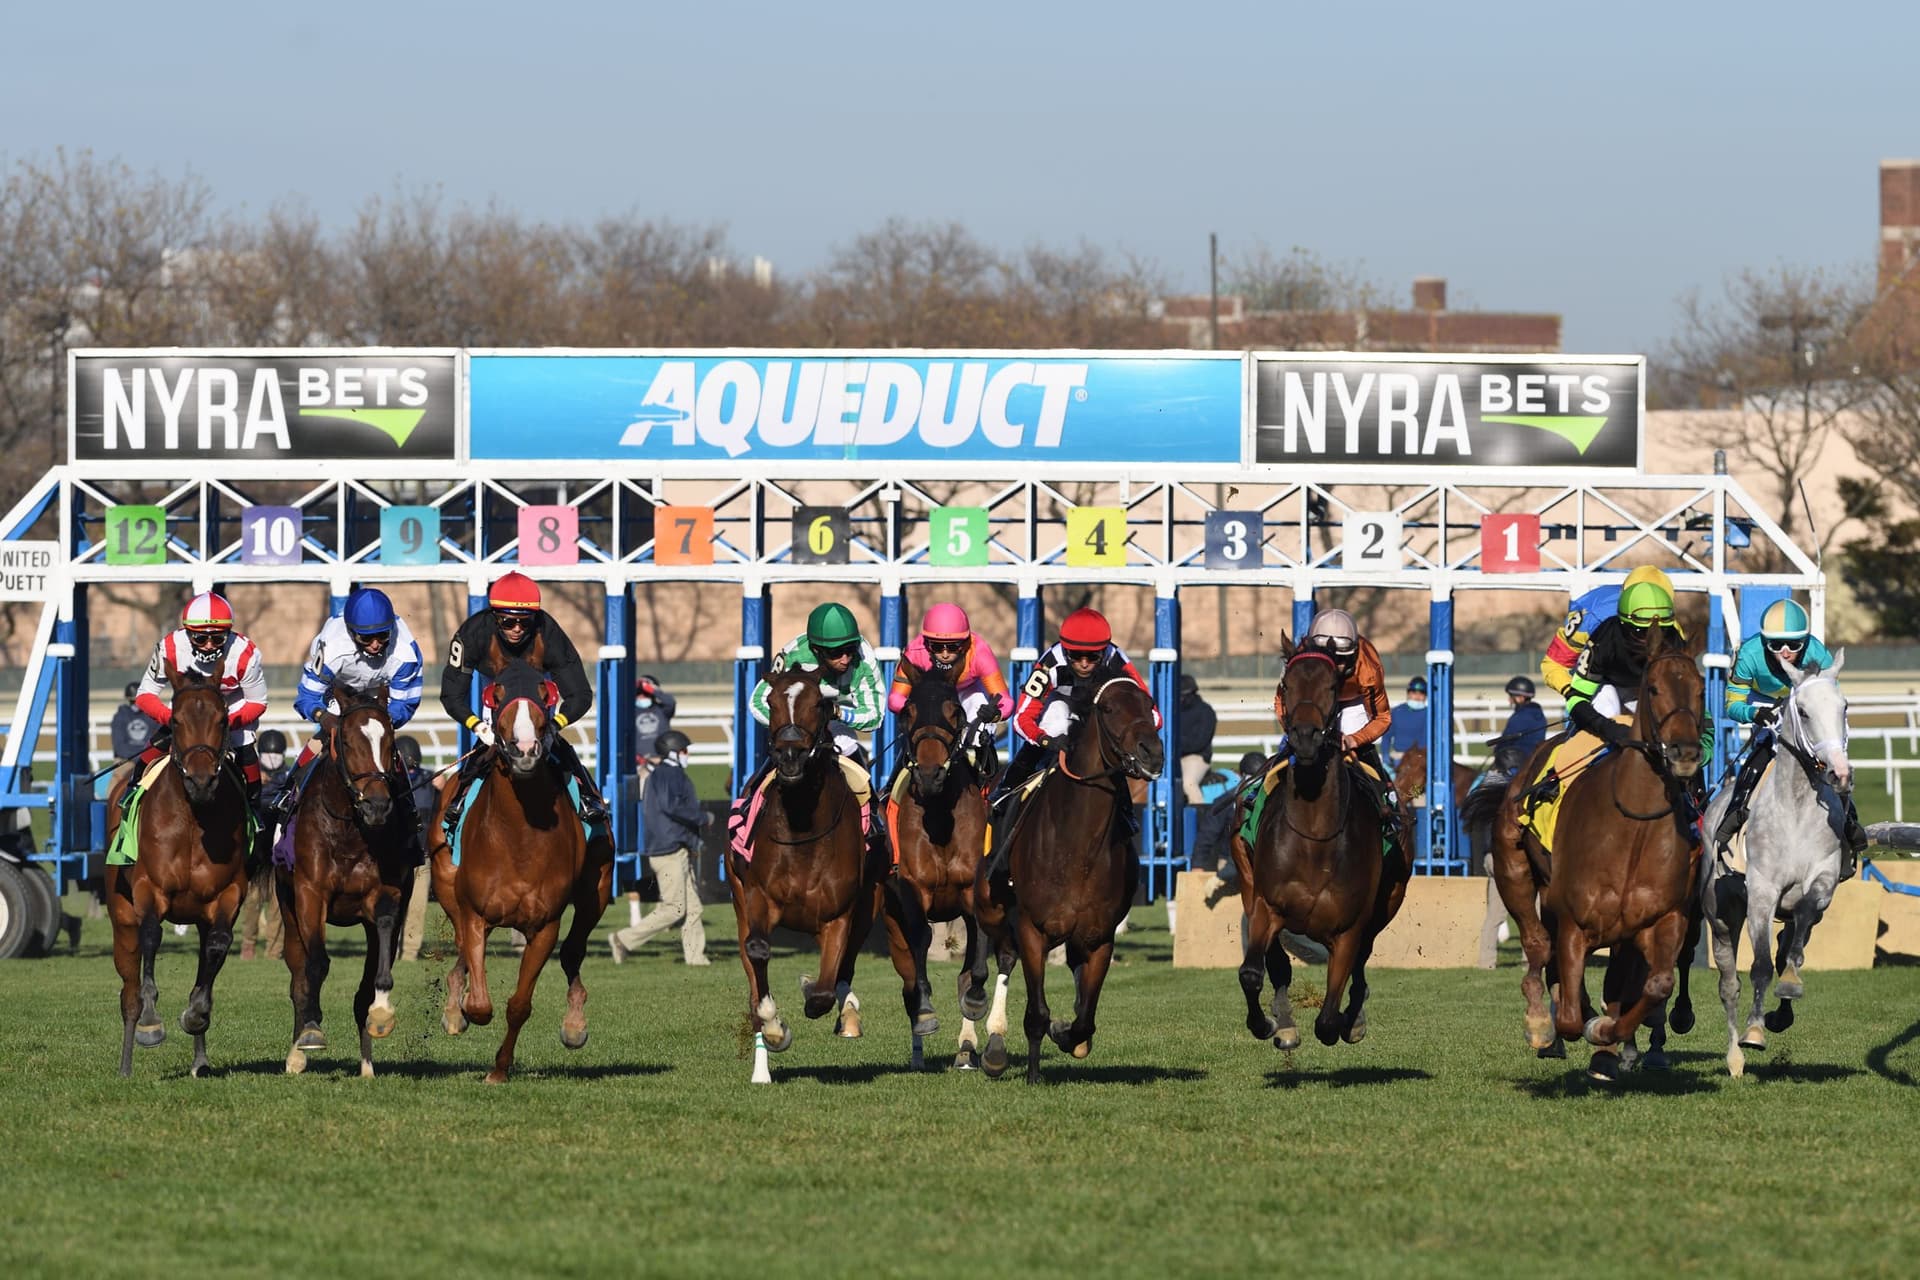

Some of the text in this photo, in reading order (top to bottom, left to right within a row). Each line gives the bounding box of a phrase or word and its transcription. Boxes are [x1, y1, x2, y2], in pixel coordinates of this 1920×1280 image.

[102, 367, 428, 450] NYRA BETS
[1283, 372, 1612, 456] NYRA BETS
[115, 517, 157, 555] 12
[250, 516, 296, 556] 10
[400, 517, 424, 555] 9
[537, 516, 561, 554] 8
[674, 518, 697, 554] 7
[808, 515, 834, 555] 6
[946, 517, 971, 556] 5
[1085, 519, 1108, 555] 4
[1223, 520, 1247, 561] 3
[1361, 522, 1384, 559] 2
[1502, 522, 1520, 562] 1
[0, 550, 51, 568] NITED
[1565, 610, 1581, 637] 3
[449, 640, 463, 668] 9
[1577, 648, 1591, 676] 4
[1024, 669, 1050, 698] 6
